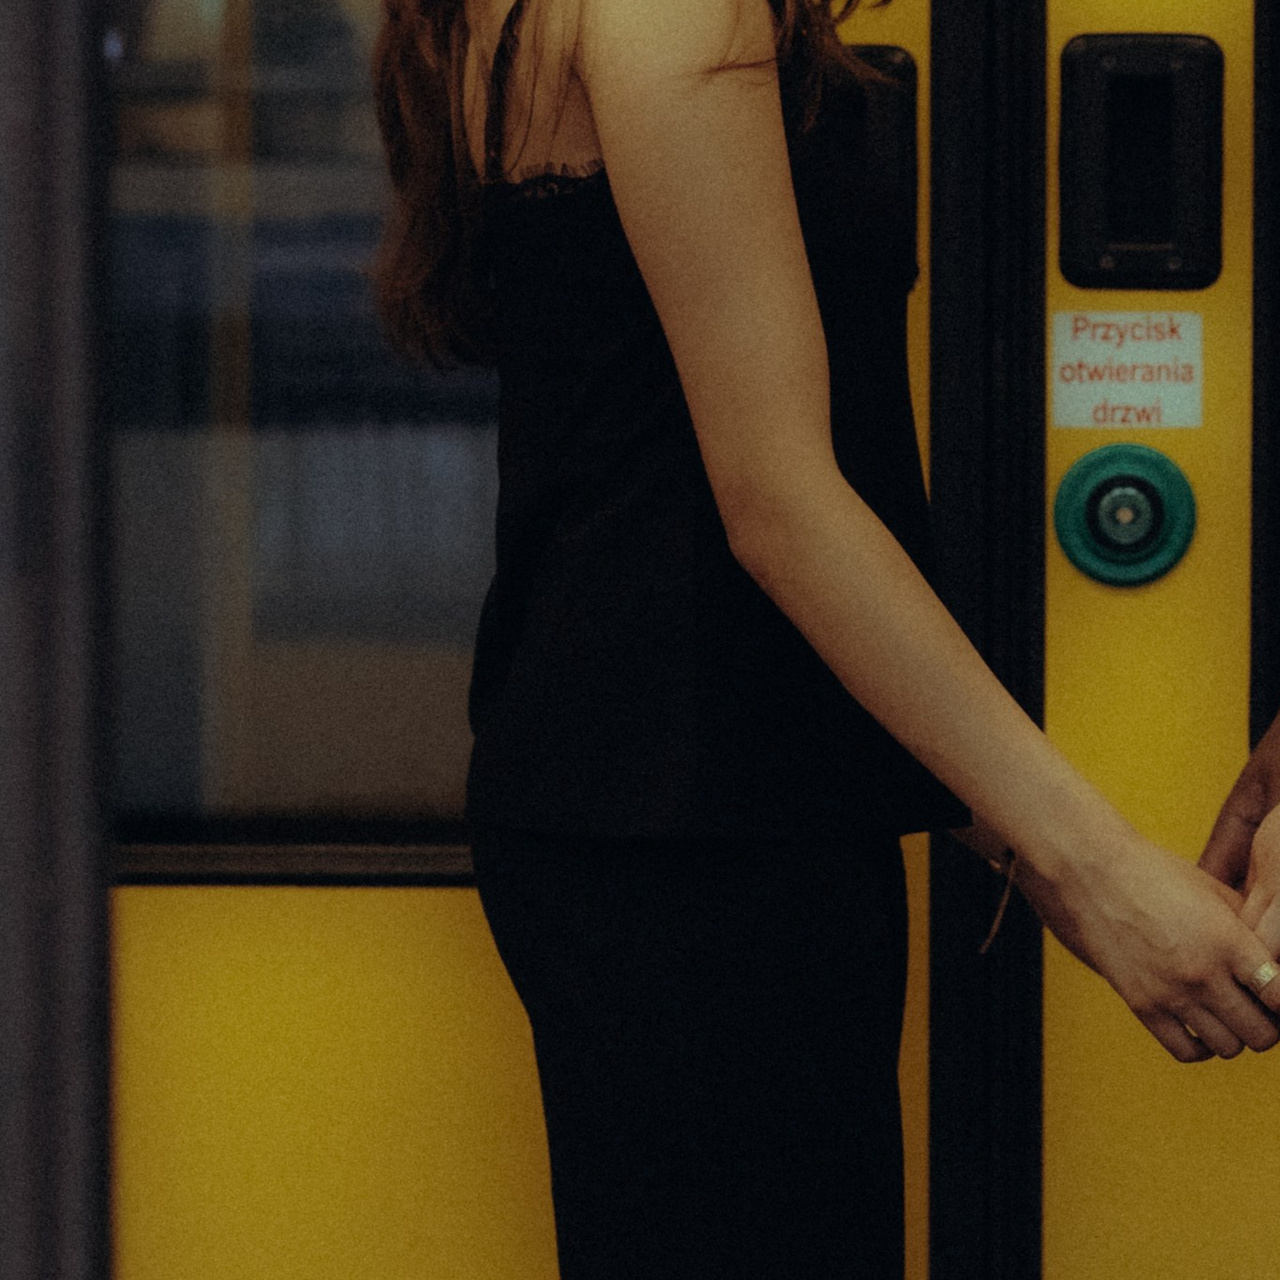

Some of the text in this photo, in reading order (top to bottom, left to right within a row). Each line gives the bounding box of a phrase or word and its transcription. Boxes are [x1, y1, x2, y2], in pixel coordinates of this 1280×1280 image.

[1071, 316, 1182, 347] Przycisk
[1059, 357, 1195, 384] otwierania
[1092, 398, 1163, 424] drzwi
